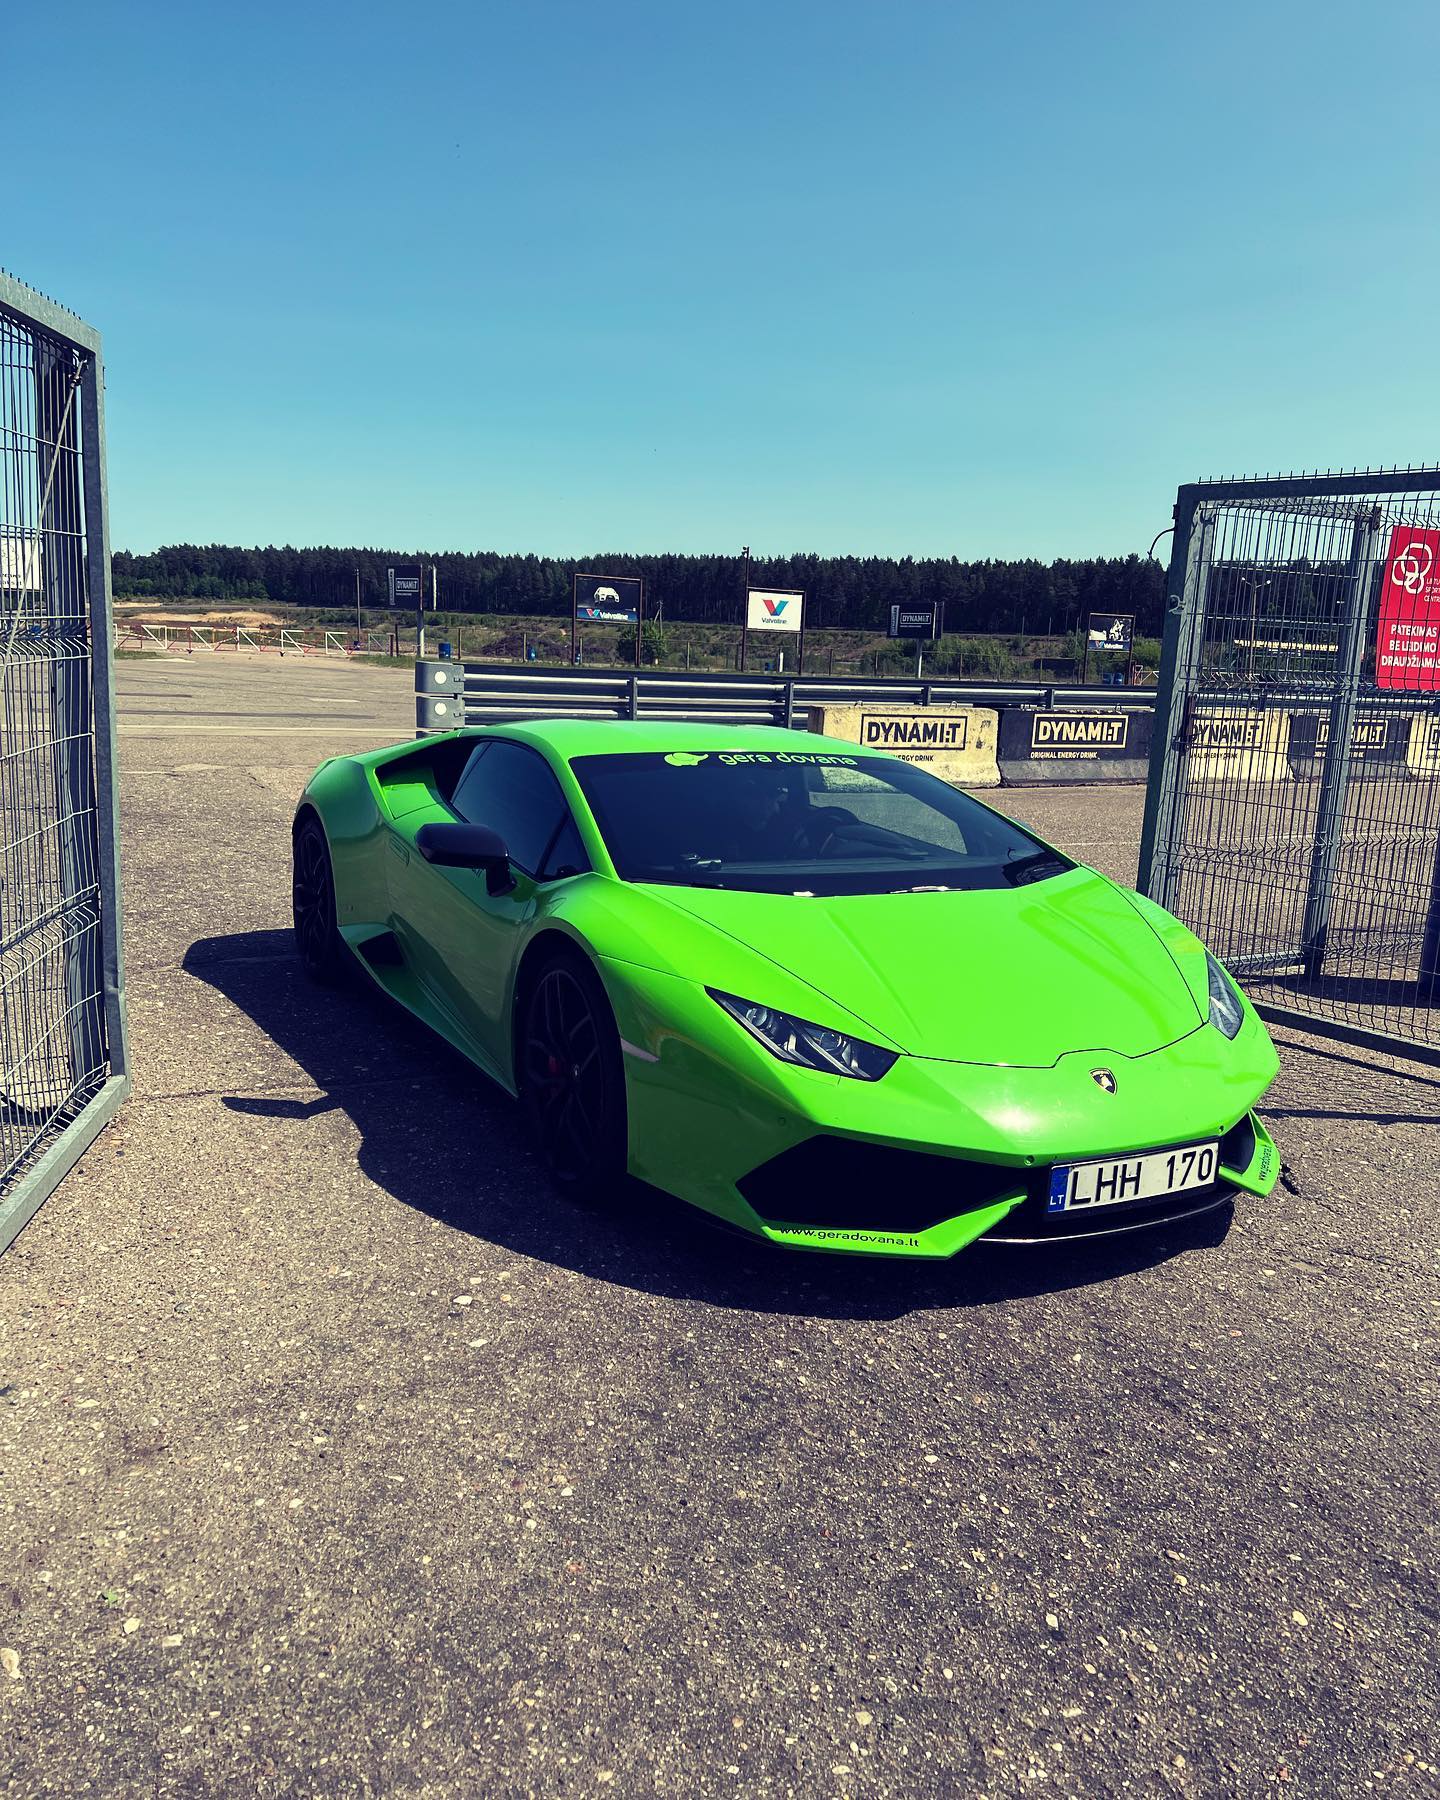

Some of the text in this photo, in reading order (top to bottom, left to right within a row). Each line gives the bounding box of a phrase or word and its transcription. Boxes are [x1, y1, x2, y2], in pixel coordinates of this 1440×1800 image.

[1389, 640, 1401, 651] BE
[717, 752, 859, 767] gera dovana
[914, 754, 935, 762] DRINK
[1030, 751, 1098, 759] ORIGINAL ENERGY DRINK
[1049, 1194, 1064, 1206] LT
[1068, 1161, 1143, 1207] LHH
[1165, 1147, 1214, 1189] 170
[780, 1227, 919, 1248] www.geradovana.lt
